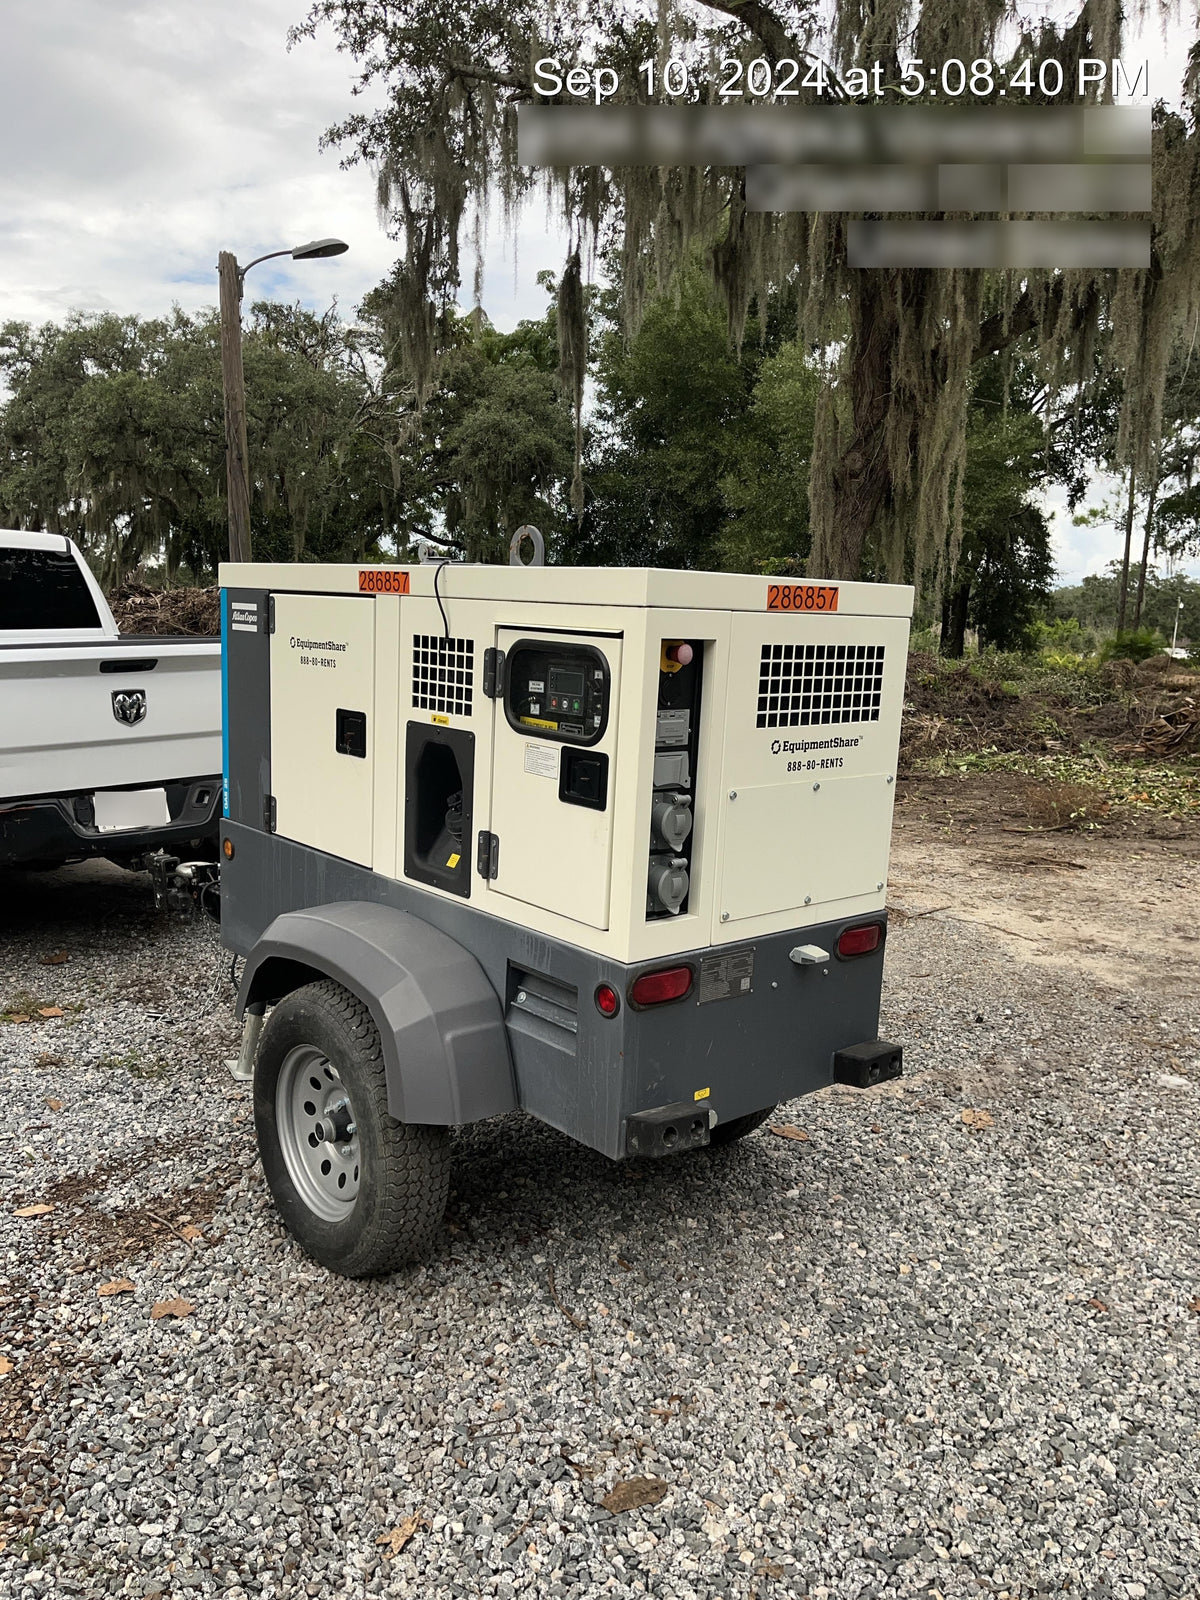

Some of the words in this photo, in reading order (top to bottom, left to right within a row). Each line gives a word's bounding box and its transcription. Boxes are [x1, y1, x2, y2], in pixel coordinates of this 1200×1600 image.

[359, 571, 409, 592] 286857
[768, 585, 838, 609] 286857
[231, 611, 245, 621] Atlas
[244, 611, 258, 624] Copco
[296, 638, 346, 651] EquipmentShare
[300, 655, 337, 669] 888-80-RENTS
[782, 737, 859, 754] EquipmentShare
[787, 757, 844, 772] 888-80-RENTS
